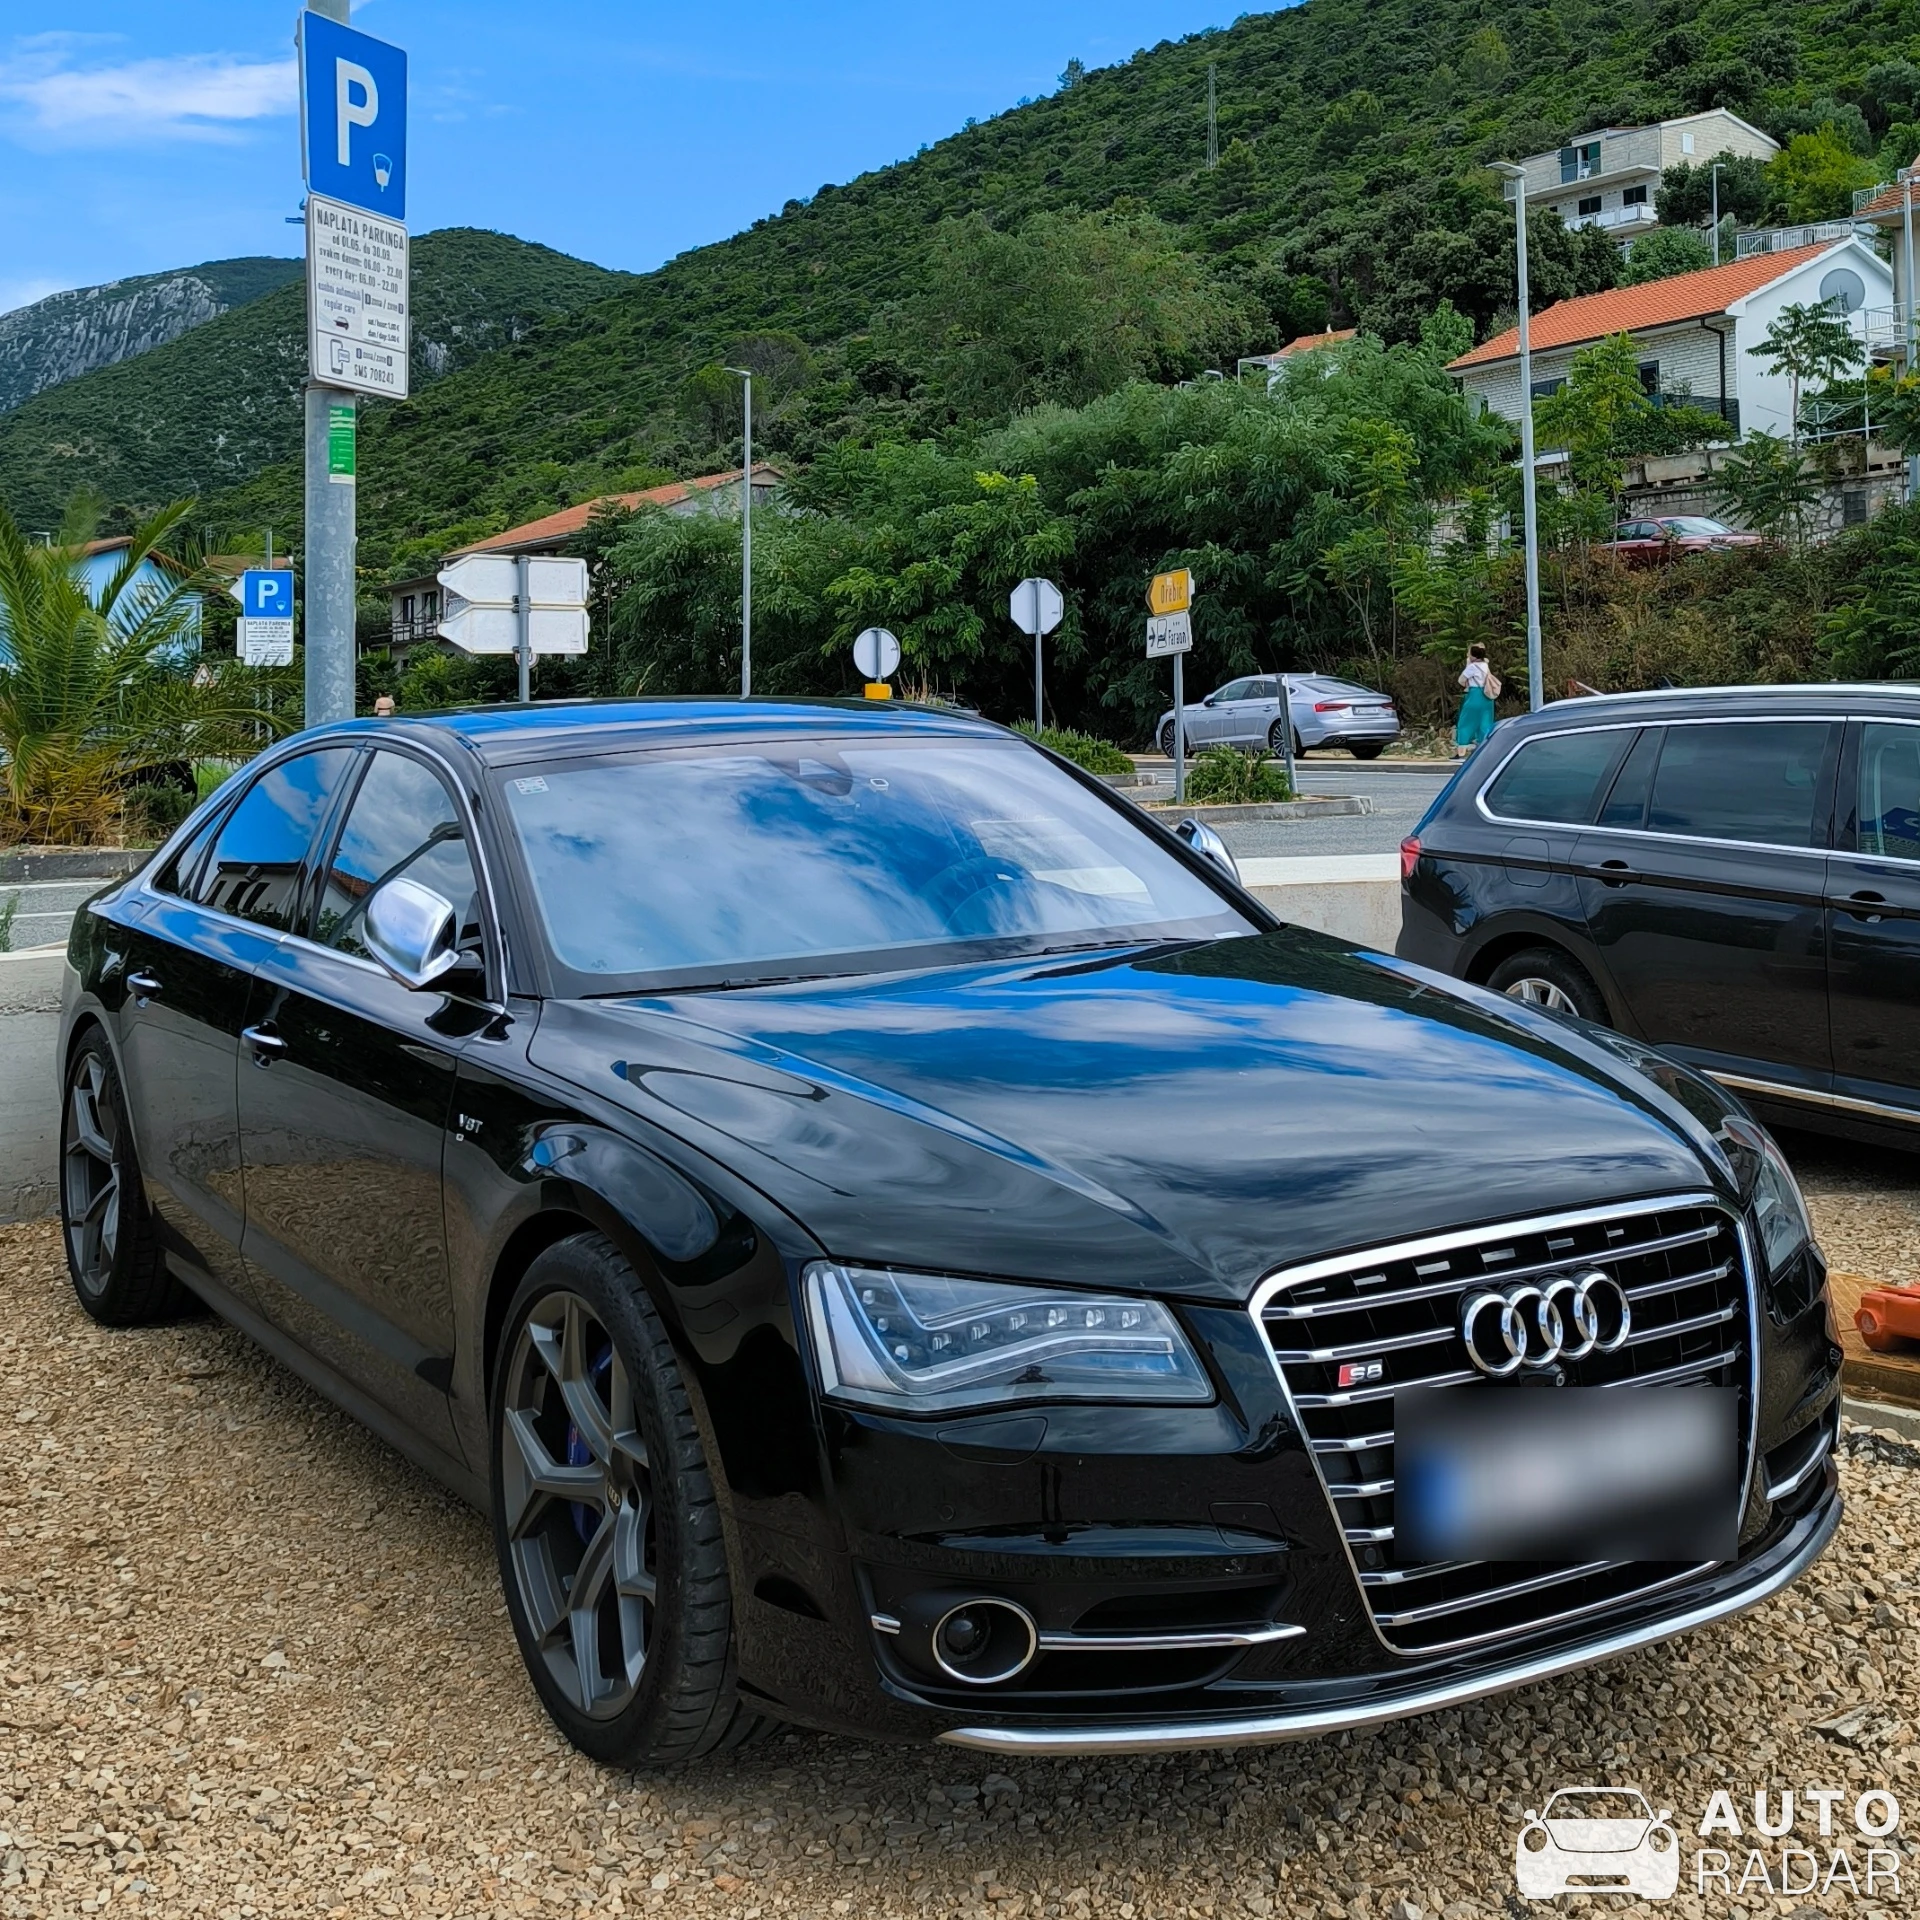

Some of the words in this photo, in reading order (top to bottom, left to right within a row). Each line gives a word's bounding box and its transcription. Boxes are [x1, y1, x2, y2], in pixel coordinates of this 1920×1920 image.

[336, 57, 379, 167] P
[317, 209, 359, 236] NAPLATA
[362, 224, 405, 250] PARKINGA
[332, 233, 340, 246] od
[319, 248, 340, 260] svakim
[325, 265, 342, 279] every
[345, 269, 357, 283] day:
[324, 299, 342, 311] regular
[344, 305, 355, 315] cars
[354, 364, 367, 378] SMS
[258, 579, 279, 609] P
[1160, 580, 1183, 604] Orebić
[1349, 1363, 1383, 1381] S8
